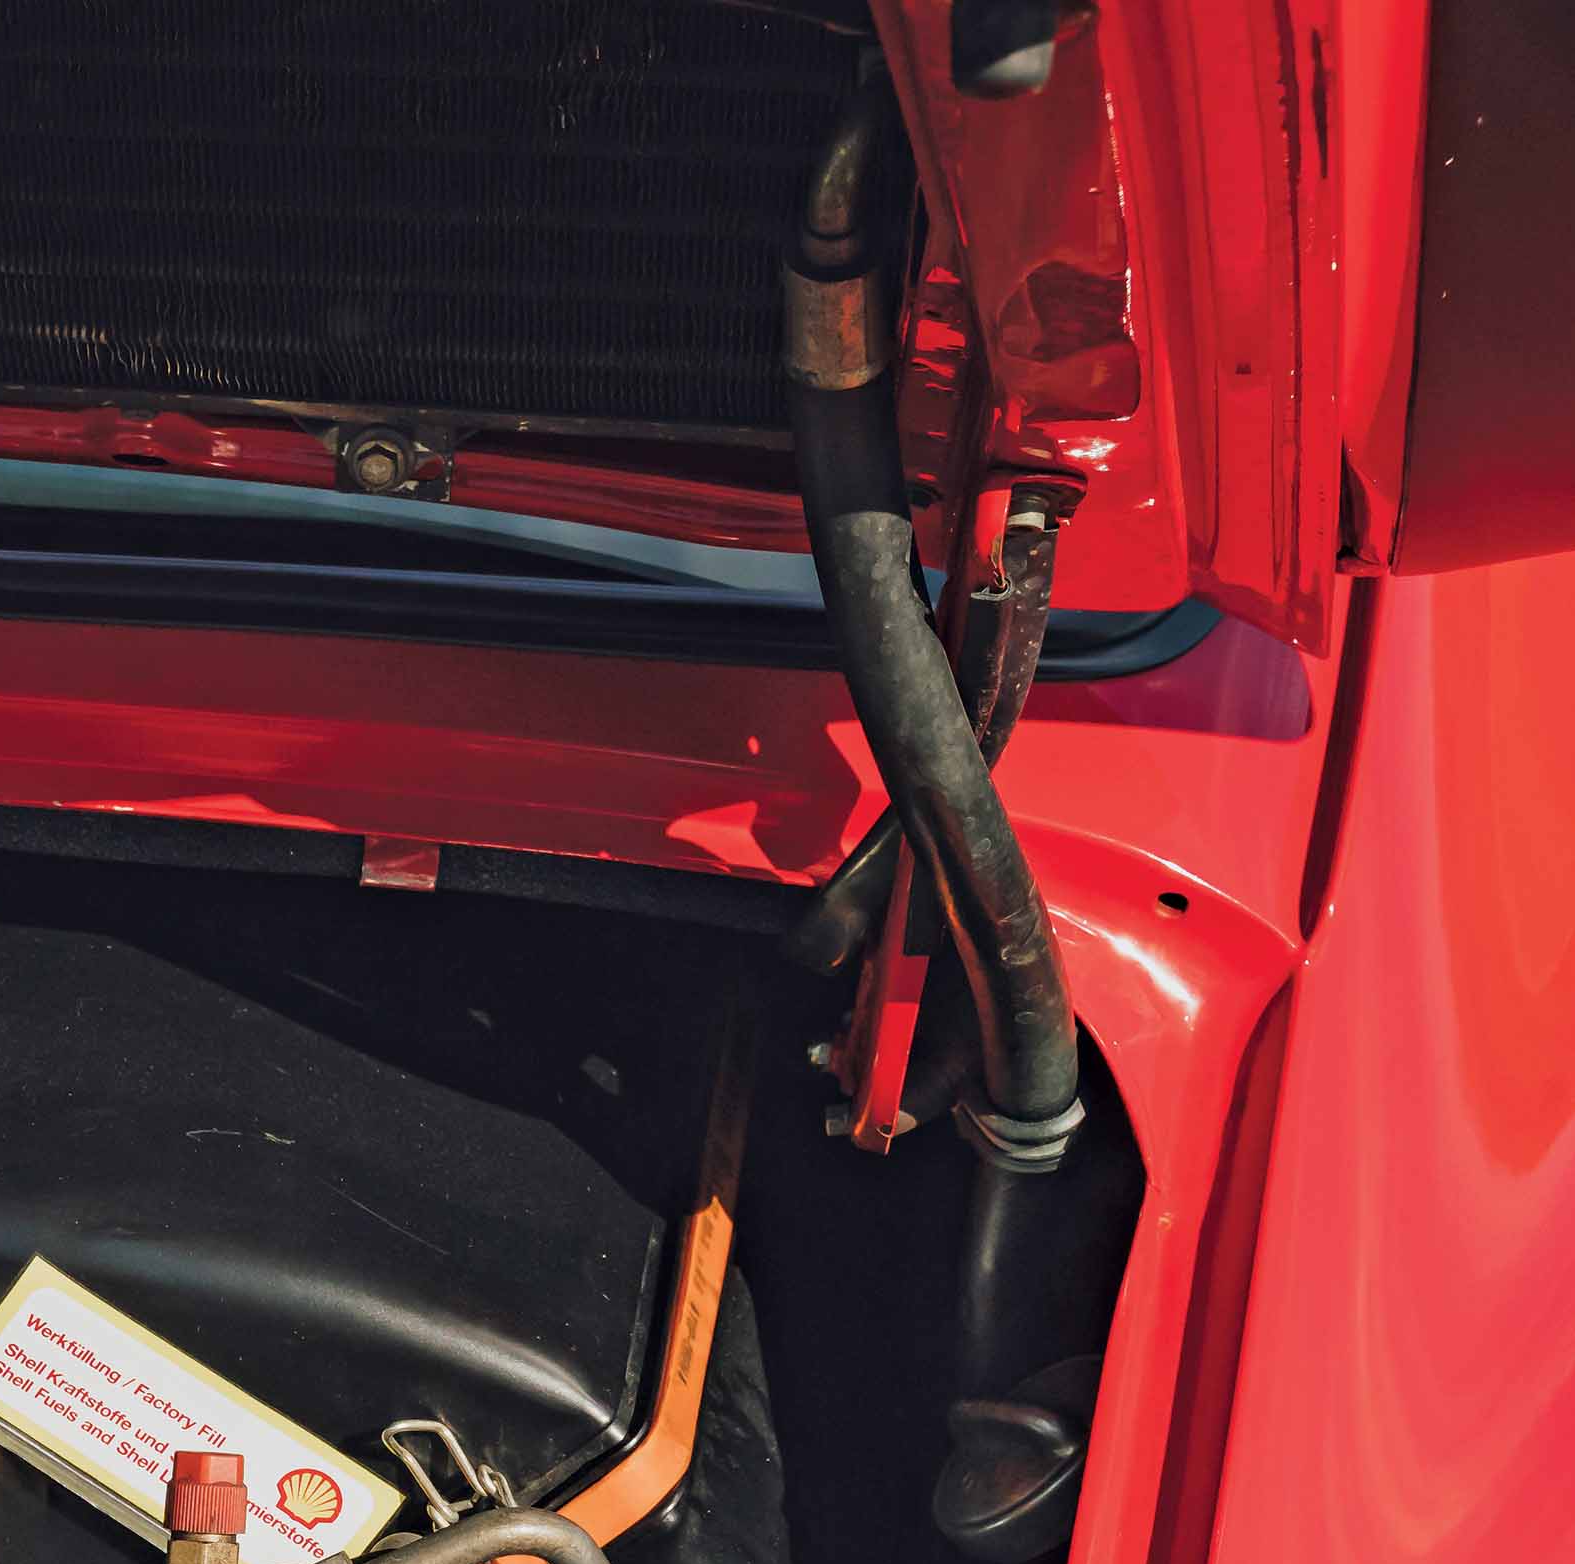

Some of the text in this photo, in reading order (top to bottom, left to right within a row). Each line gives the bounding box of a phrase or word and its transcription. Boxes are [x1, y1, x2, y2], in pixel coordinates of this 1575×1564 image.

[27, 1314, 226, 1448] Werkfüllung / Factory Fill
[35, 1387, 78, 1422] Fuels
[81, 1421, 115, 1446] and
[117, 1441, 159, 1474] Shell
[5, 1343, 324, 1558] Shell Kraftstoffe und mierstoffe
